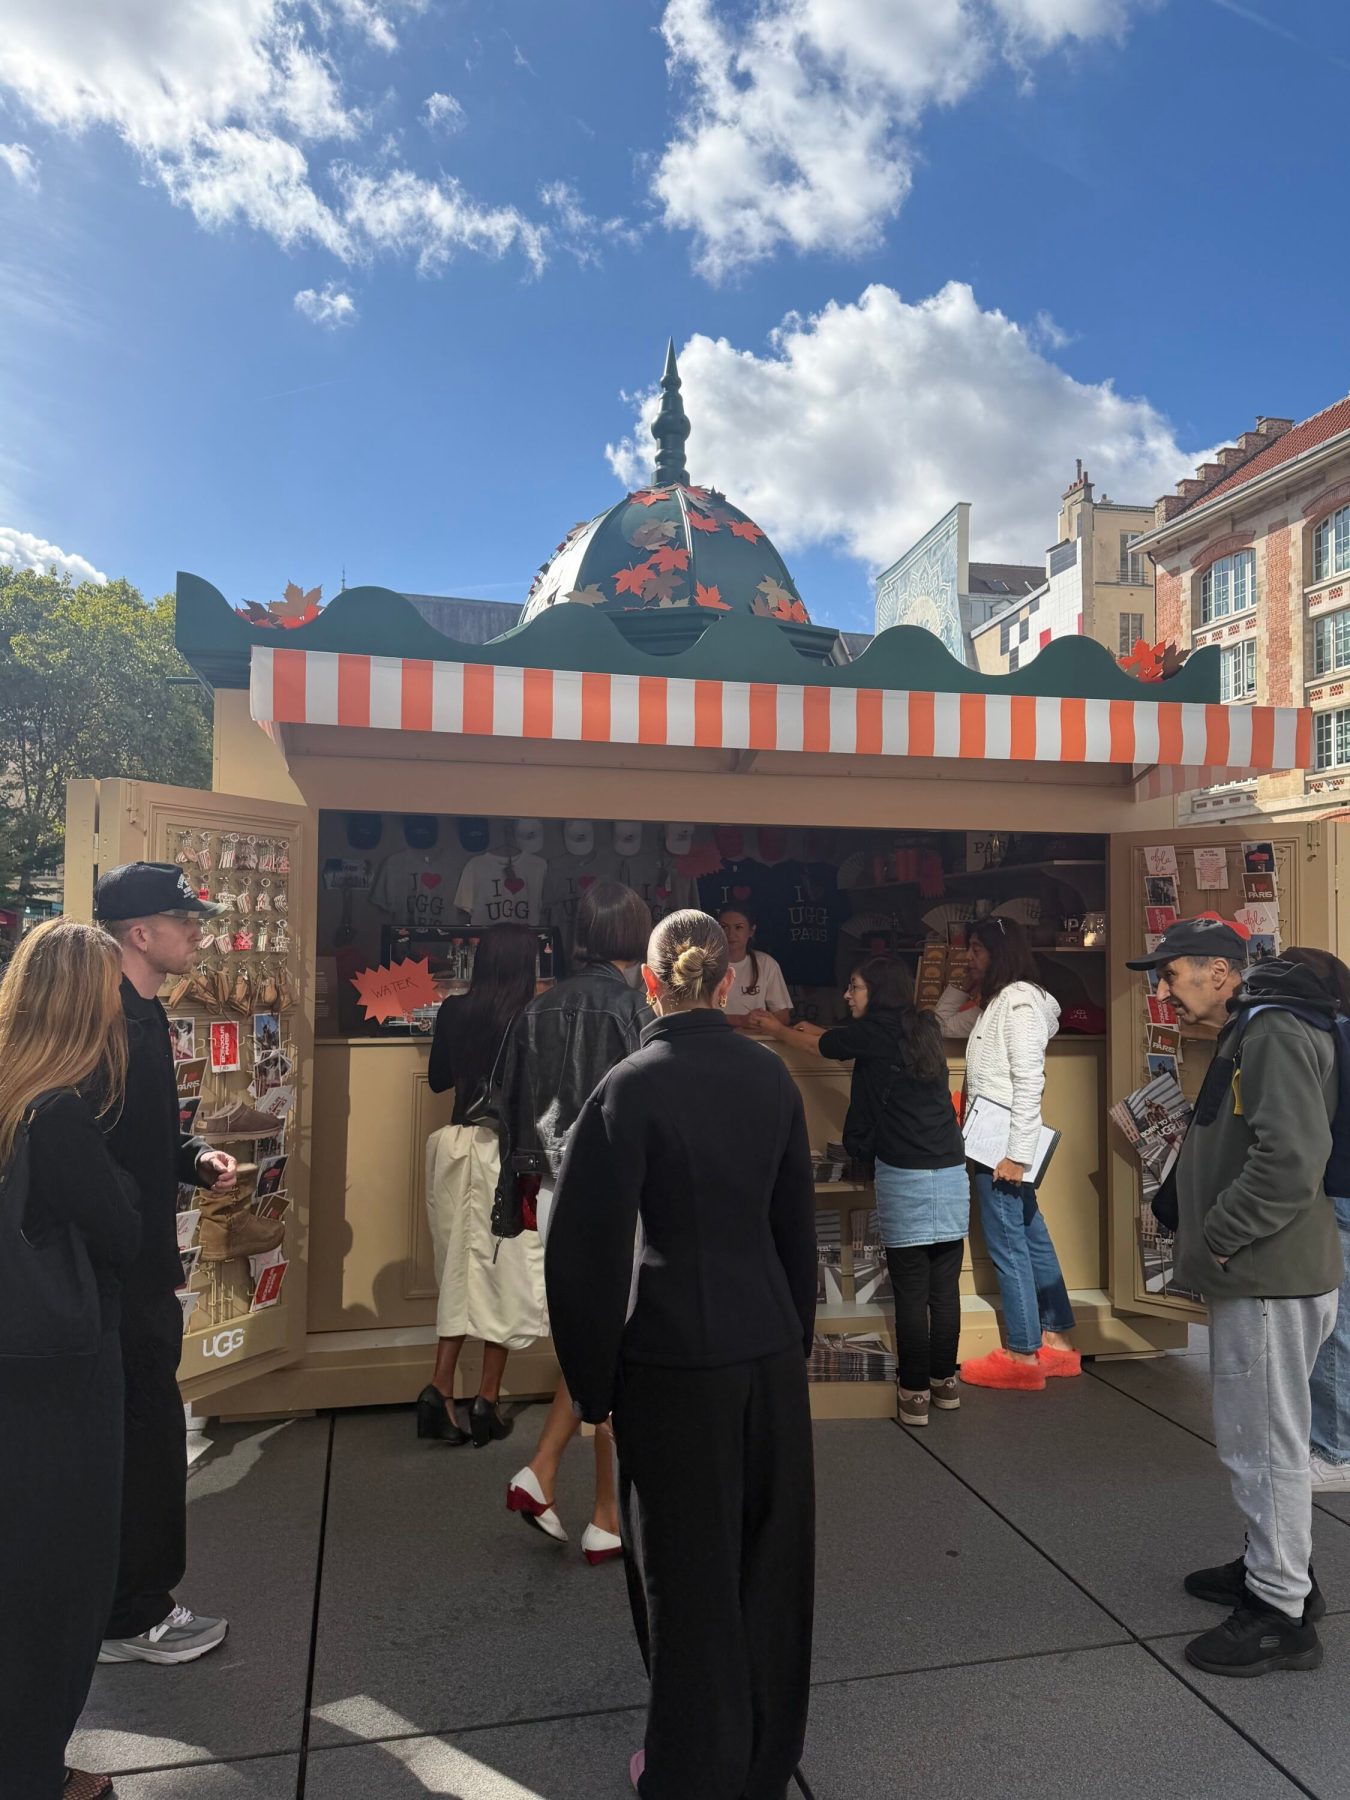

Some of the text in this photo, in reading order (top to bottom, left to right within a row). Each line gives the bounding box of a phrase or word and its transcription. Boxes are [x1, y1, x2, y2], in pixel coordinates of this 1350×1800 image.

[410, 872, 418, 890] I
[491, 879, 502, 897] I
[721, 886, 730, 904] I
[792, 885, 805, 903] I
[1248, 891, 1273, 899] PARIS
[486, 899, 530, 920] UGG
[787, 906, 832, 926] UGG
[790, 928, 828, 943] PARIS
[371, 976, 419, 999] WATER
[1152, 1041, 1176, 1054] PARIS
[177, 1079, 200, 1091] PARIS
[1140, 1125, 1159, 1138] BORN
[1158, 1119, 1168, 1127] TO
[202, 1328, 245, 1358] UGG
